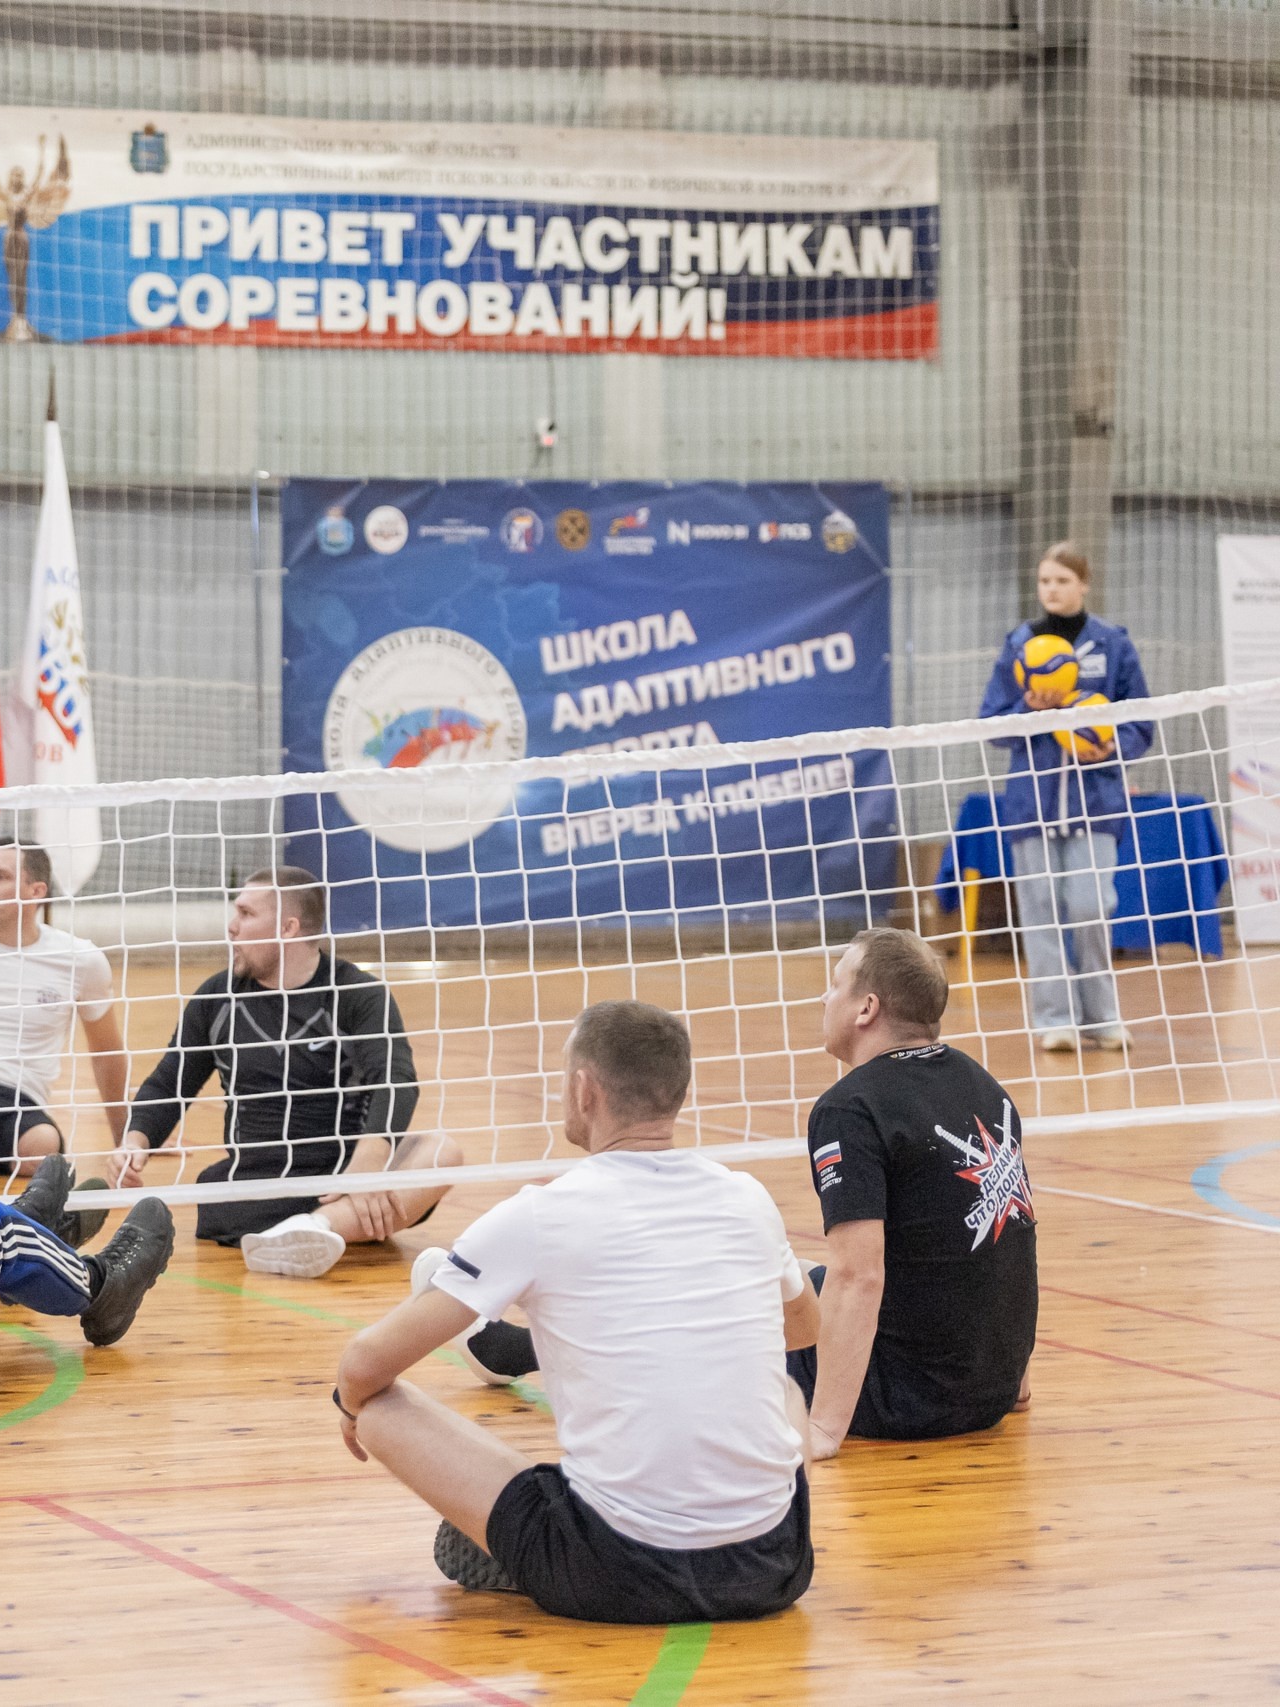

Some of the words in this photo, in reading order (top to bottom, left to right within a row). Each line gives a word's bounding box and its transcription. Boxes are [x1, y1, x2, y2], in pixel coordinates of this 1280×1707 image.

[129, 203, 416, 267] ПРИВЕТ
[437, 213, 914, 280] УЧАСТНИКАМ
[127, 272, 728, 341] СОРЕВНОВАНИЙ!
[538, 609, 698, 675] ШКОЛА
[550, 631, 858, 733] АДАПТИВНОГО
[540, 797, 681, 858] ВПЕРЕД
[681, 784, 711, 826] К
[982, 1145, 1013, 1198] ДЕЛАЙ
[967, 1197, 997, 1227] ЧТО
